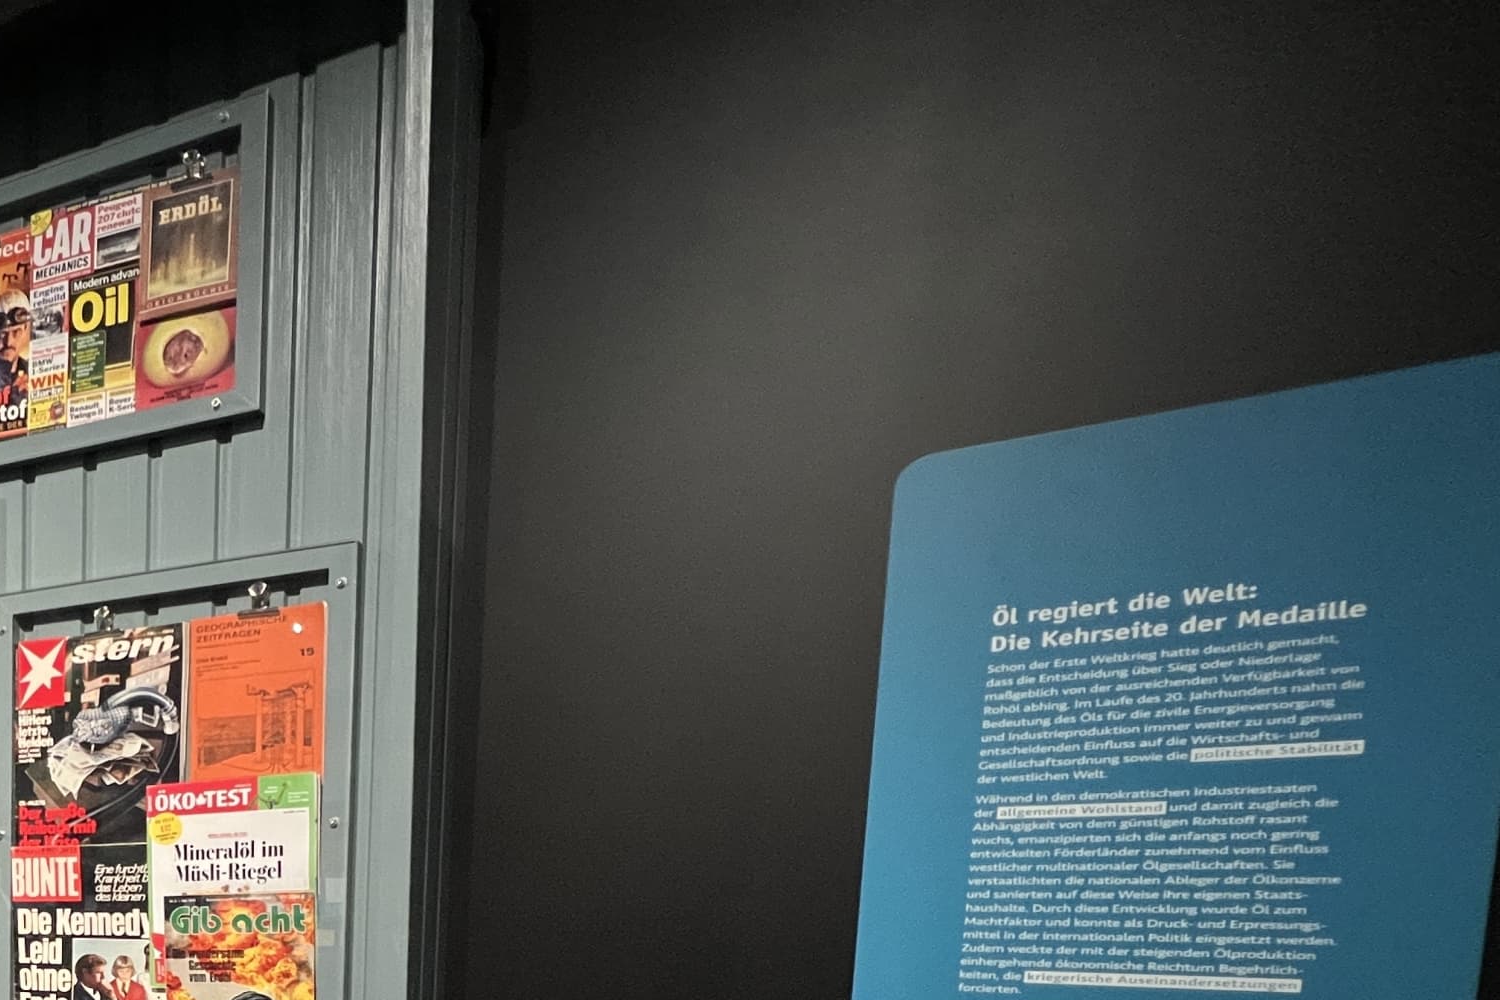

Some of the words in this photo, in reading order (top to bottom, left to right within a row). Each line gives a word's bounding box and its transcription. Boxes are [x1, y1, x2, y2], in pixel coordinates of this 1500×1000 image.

[98, 196, 137, 213] Peugeot
[158, 194, 222, 226] ERDÖL
[34, 212, 92, 266] CAR
[36, 256, 88, 280] MECHANICS
[74, 276, 108, 292] Modern
[72, 282, 128, 332] Oil
[31, 372, 64, 390] WIN
[992, 609, 1017, 627] Öl
[1028, 599, 1118, 627] regiert
[1129, 594, 1171, 612] die
[1184, 585, 1259, 606] Welt:
[196, 628, 261, 644] ZEITFRAGEN
[990, 635, 1033, 653] Die
[1041, 622, 1170, 648] Kehrseite
[1179, 616, 1228, 634] der
[1238, 602, 1368, 627] Medaille
[72, 634, 176, 664] stern
[987, 661, 1027, 673] Schon
[1028, 659, 1052, 669] der
[1053, 656, 1089, 667] Erste
[1091, 650, 1158, 666] Weltkrieg
[1161, 646, 1201, 658] hatte
[1203, 641, 1264, 654] deutlich
[985, 676, 1015, 686] dass
[1016, 674, 1037, 684] die
[1038, 667, 1130, 685] Entscheidung
[1131, 664, 1164, 675] über
[1167, 662, 1198, 675] Sieg
[1200, 659, 1234, 670] oder
[1238, 652, 1322, 670] Niederlage
[979, 755, 1120, 771] Gesellschaftsordnung
[1124, 753, 1163, 763] sowie
[1167, 752, 1187, 761] die
[1195, 747, 1275, 762] politische
[1280, 743, 1360, 755] Stabilität
[156, 790, 197, 813] ÖKO
[206, 786, 252, 807] TEST
[1000, 805, 1077, 818] allgemeine
[1081, 803, 1164, 813] Wohlstand
[174, 842, 255, 862] Mineralöl
[262, 840, 284, 858] im
[12, 857, 79, 898] BUNTE
[94, 864, 114, 875] Eine
[94, 873, 140, 884] Krankheit
[176, 860, 282, 884] Müsli-Riegel
[112, 893, 146, 902] kleinen
[113, 884, 142, 894] Leben
[18, 908, 54, 936] Die
[170, 906, 222, 934] Gib
[232, 904, 306, 933] acht
[18, 936, 63, 965] Leid
[20, 965, 72, 993] ohne
[1028, 973, 1114, 986] kriegerische
[1117, 976, 1298, 992] Auseinandersetzungen
